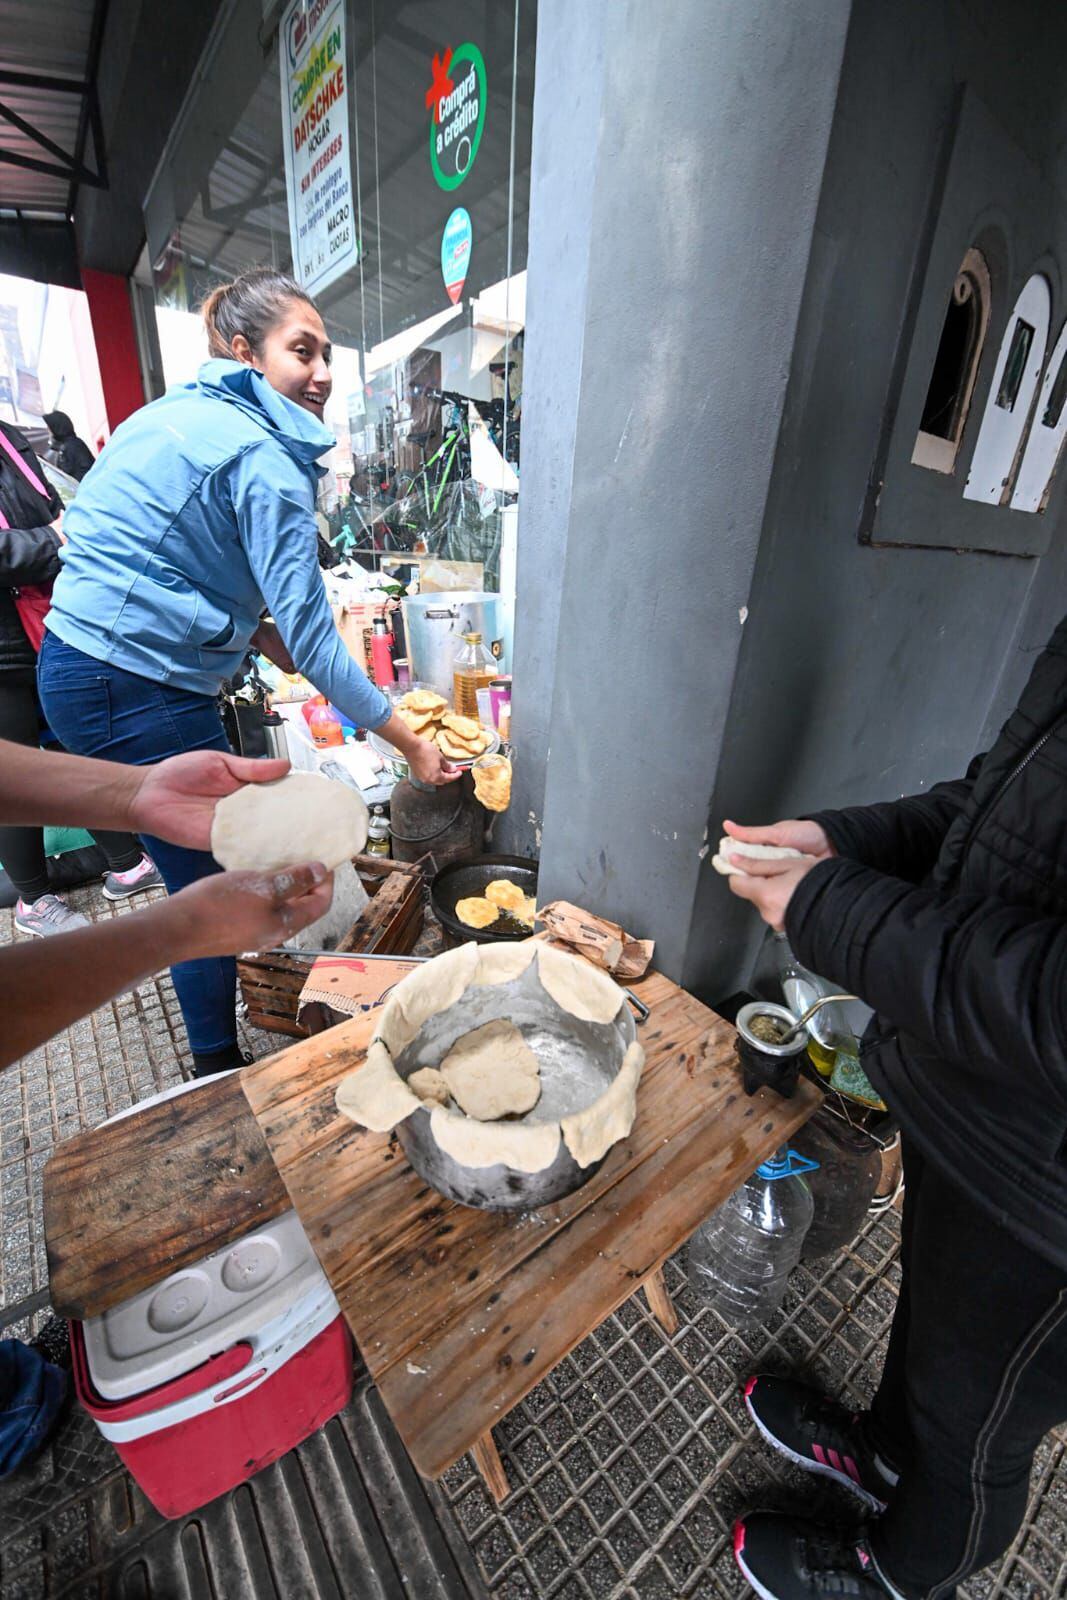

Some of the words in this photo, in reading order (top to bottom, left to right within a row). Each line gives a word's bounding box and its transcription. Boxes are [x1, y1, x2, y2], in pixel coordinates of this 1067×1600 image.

[291, 45, 327, 113] COMPRE
[327, 24, 341, 64] EN
[439, 61, 476, 123] Comprá
[294, 64, 344, 153] DATSCHKE
[436, 133, 443, 155] a
[444, 98, 479, 146] crédito
[308, 118, 331, 157] HOGAR
[311, 133, 343, 184] INTERESES
[332, 180, 349, 205] Banco
[327, 203, 350, 234] MACRO
[330, 226, 350, 255] CUOTAS
